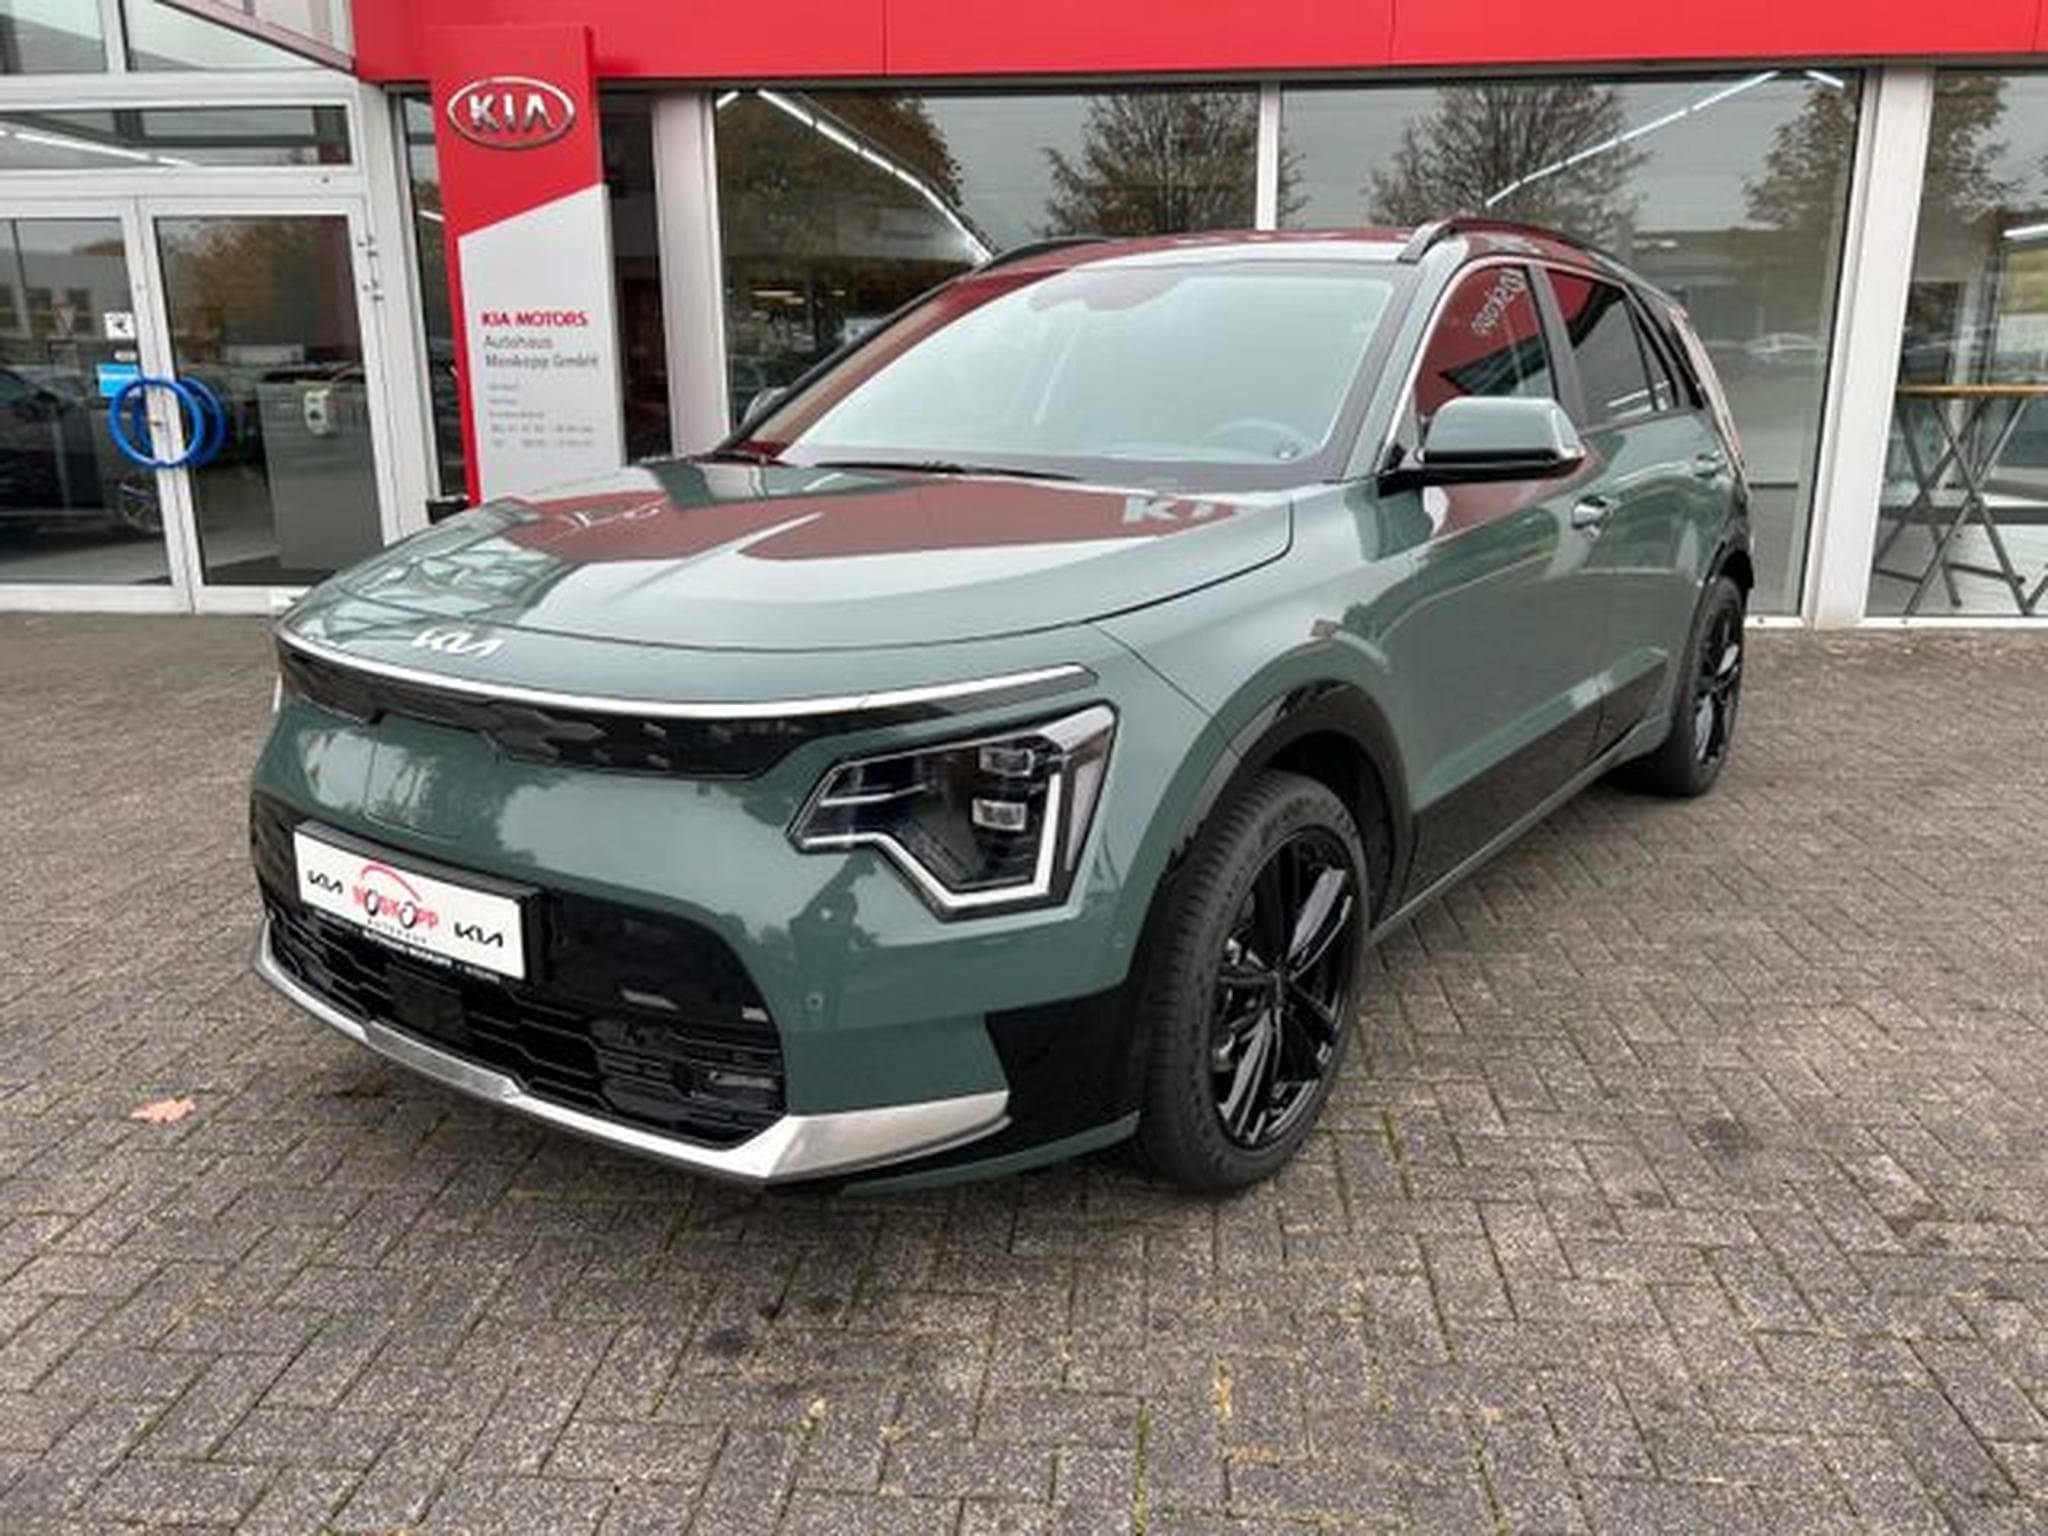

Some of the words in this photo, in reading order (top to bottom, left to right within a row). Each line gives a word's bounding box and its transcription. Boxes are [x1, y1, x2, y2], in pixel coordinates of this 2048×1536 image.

[468, 92, 556, 131] KIA
[481, 311, 511, 327] KIA
[515, 311, 588, 327] MOTORS
[483, 335, 553, 349] Autohaus
[411, 626, 505, 658] KIA
[306, 868, 344, 895] KIA
[453, 919, 504, 948] KIA
